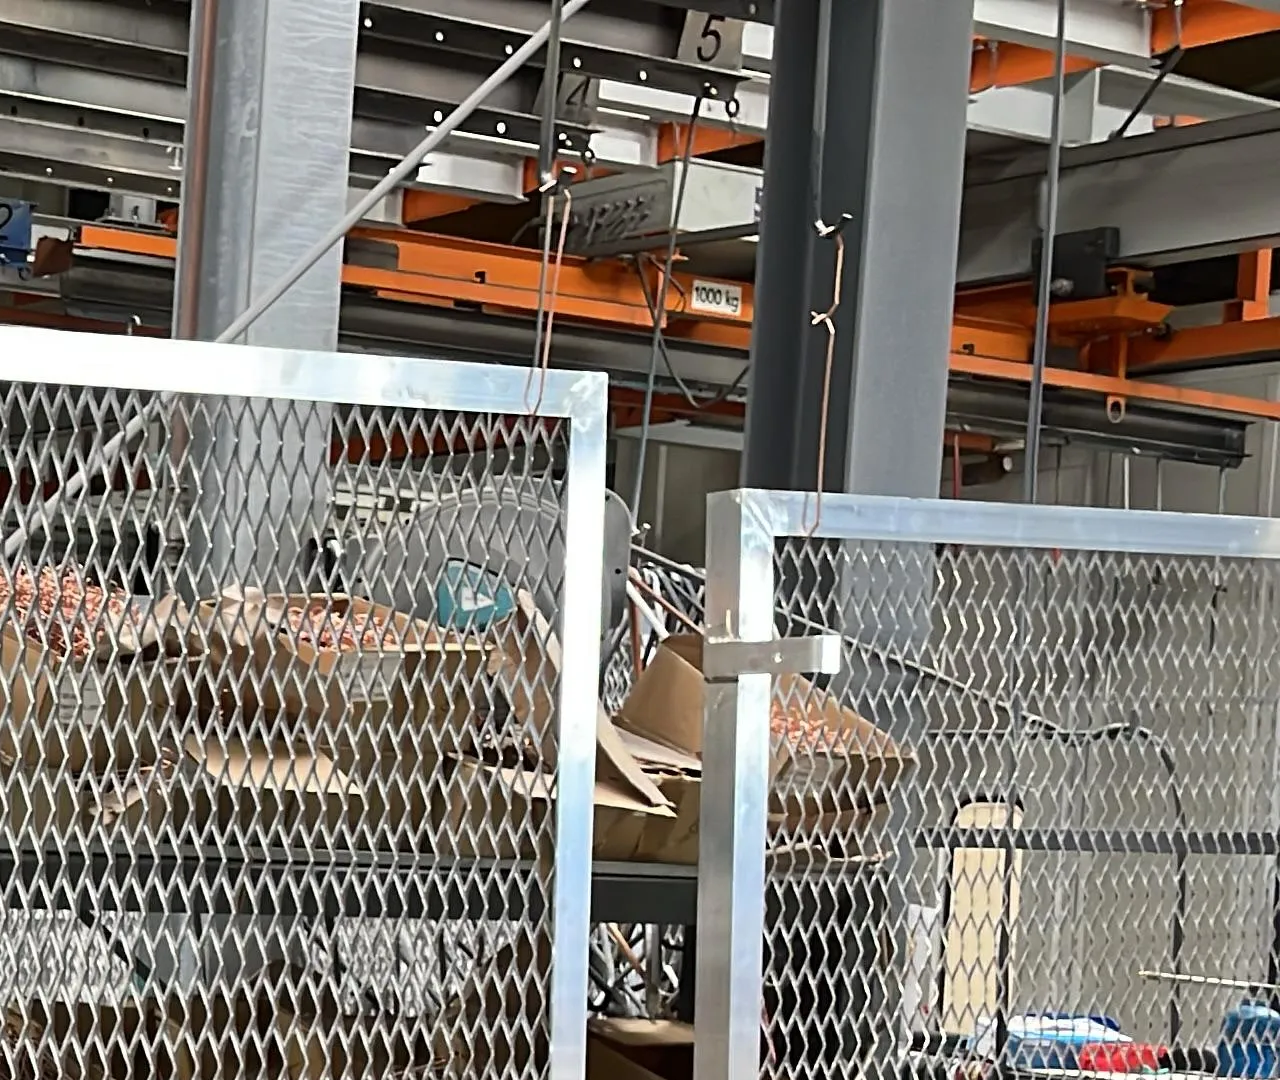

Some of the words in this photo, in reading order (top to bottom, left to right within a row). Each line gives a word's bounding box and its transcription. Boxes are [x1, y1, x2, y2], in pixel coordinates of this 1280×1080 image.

[696, 14, 726, 62] 5
[565, 76, 591, 112] 4
[695, 286, 722, 305] 1000
[726, 290, 739, 312] kg
